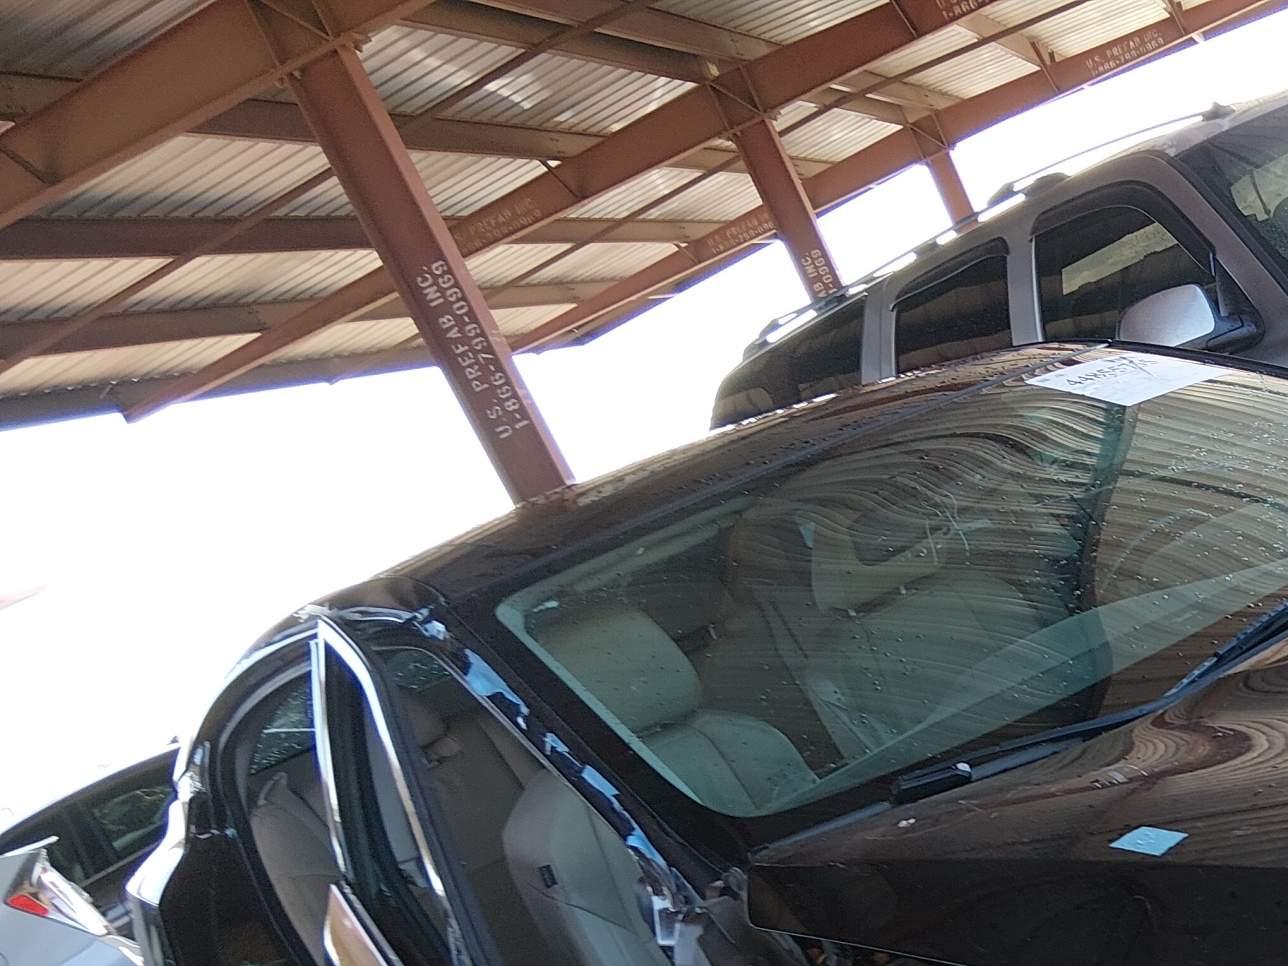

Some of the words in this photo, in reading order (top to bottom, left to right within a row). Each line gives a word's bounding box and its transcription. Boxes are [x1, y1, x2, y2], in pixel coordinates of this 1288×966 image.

[416, 266, 445, 307] INC.
[431, 260, 530, 429] 1-866-799-0969
[438, 315, 488, 393] PREFAB
